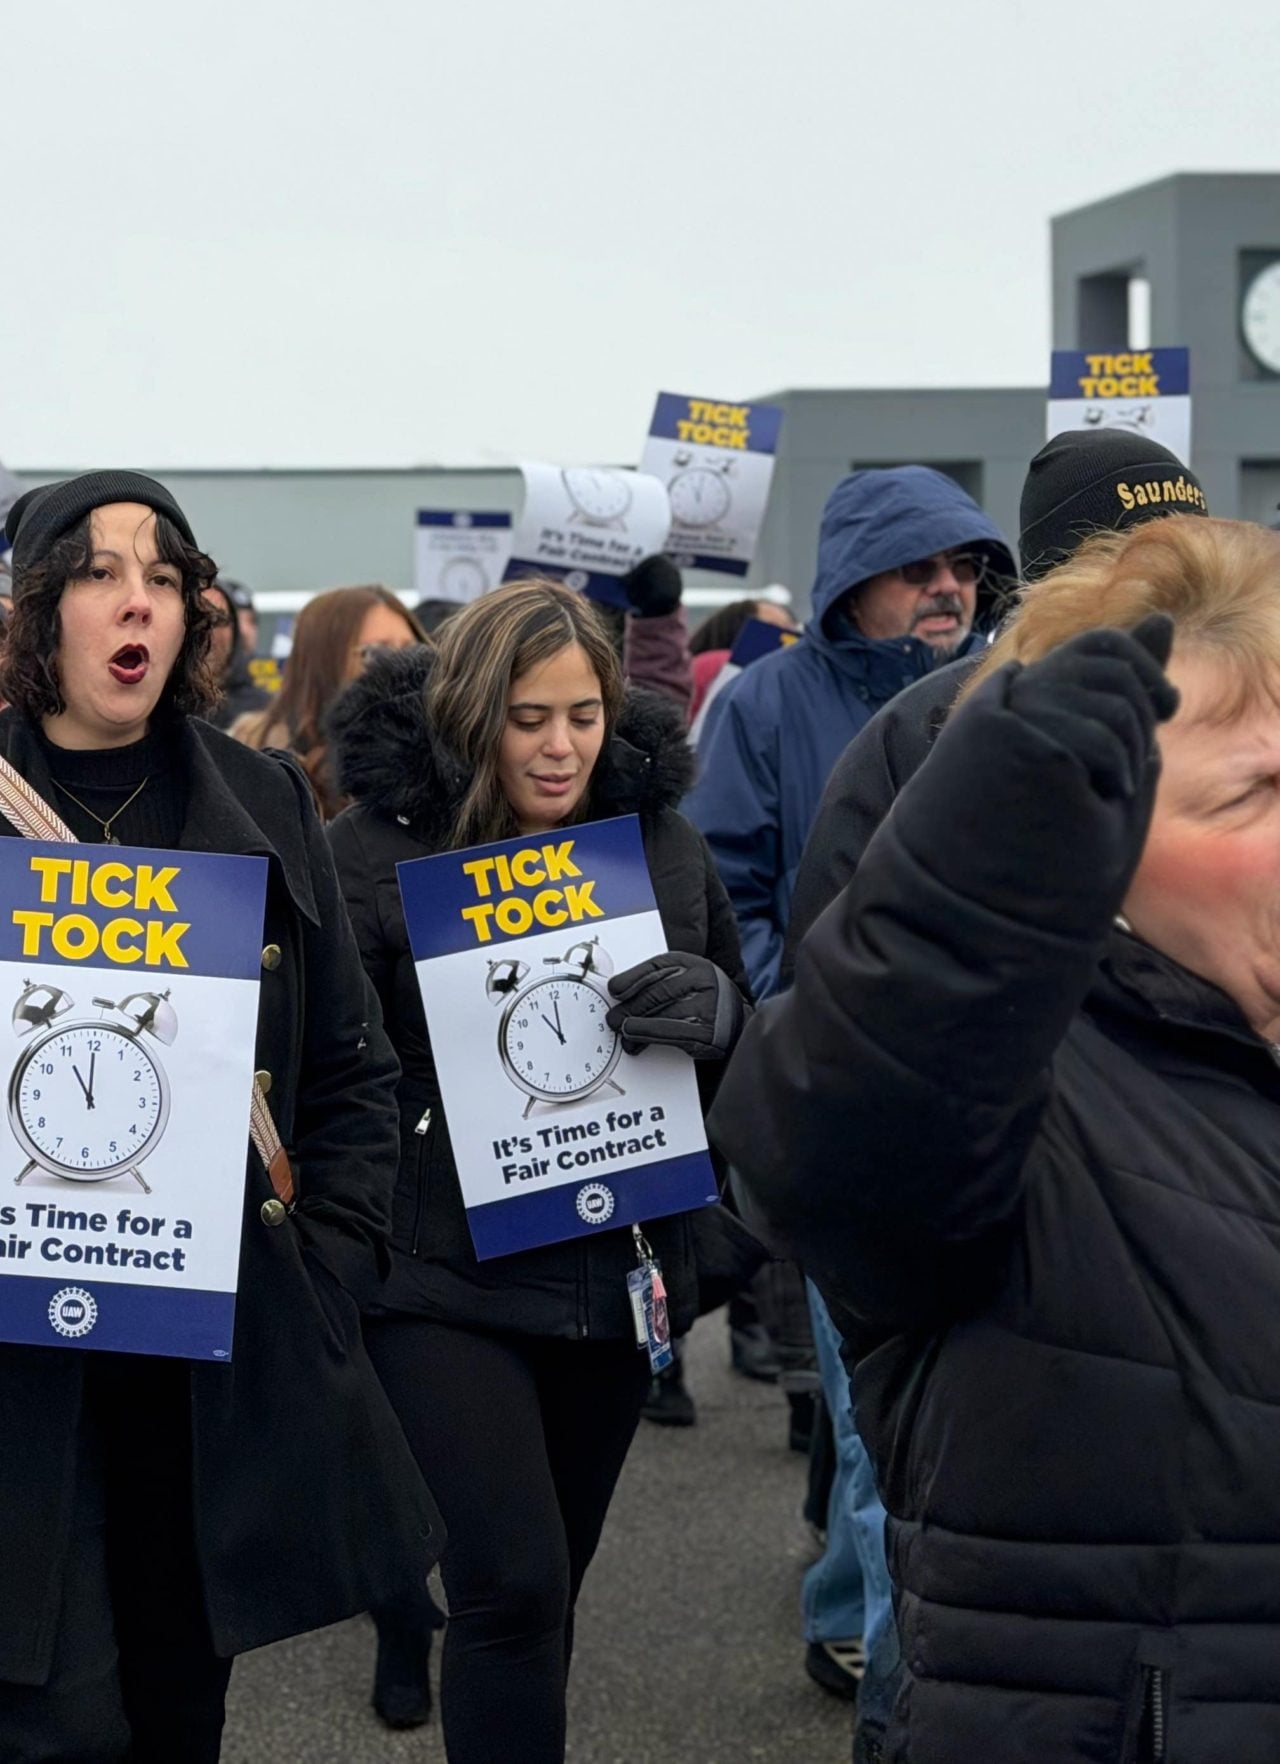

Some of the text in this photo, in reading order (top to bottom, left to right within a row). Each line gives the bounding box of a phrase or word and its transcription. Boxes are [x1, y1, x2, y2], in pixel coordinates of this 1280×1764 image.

[1085, 352, 1153, 376] TICK
[1078, 374, 1159, 399] TOCK
[688, 400, 751, 428] TICK
[676, 419, 751, 450] TOCK
[462, 840, 583, 897] TICK
[30, 856, 182, 912] TICK
[461, 880, 606, 942] TOCK
[12, 910, 192, 968] TOCK
[549, 990, 560, 1000] 12
[529, 1001, 539, 1010] 11
[517, 1019, 528, 1029] 10
[60, 1045, 72, 1057] 11
[87, 1040, 101, 1052] 12
[118, 1050, 124, 1061] 1
[40, 1063, 54, 1075] 10
[133, 1070, 141, 1082] 2
[33, 1089, 41, 1100] 9
[138, 1097, 146, 1109] 3
[38, 1116, 46, 1128] 8
[129, 1124, 137, 1135] 4
[492, 1106, 665, 1160] It's Time for a
[56, 1137, 63, 1148] 7
[109, 1141, 117, 1152] 5
[81, 1147, 89, 1158] 6
[502, 1128, 667, 1185] Fair Contract
[25, 1202, 108, 1233] Time
[116, 1209, 166, 1237] for
[173, 1219, 193, 1239] a
[40, 1237, 186, 1272] Contract
[62, 1305, 83, 1318] UAW
